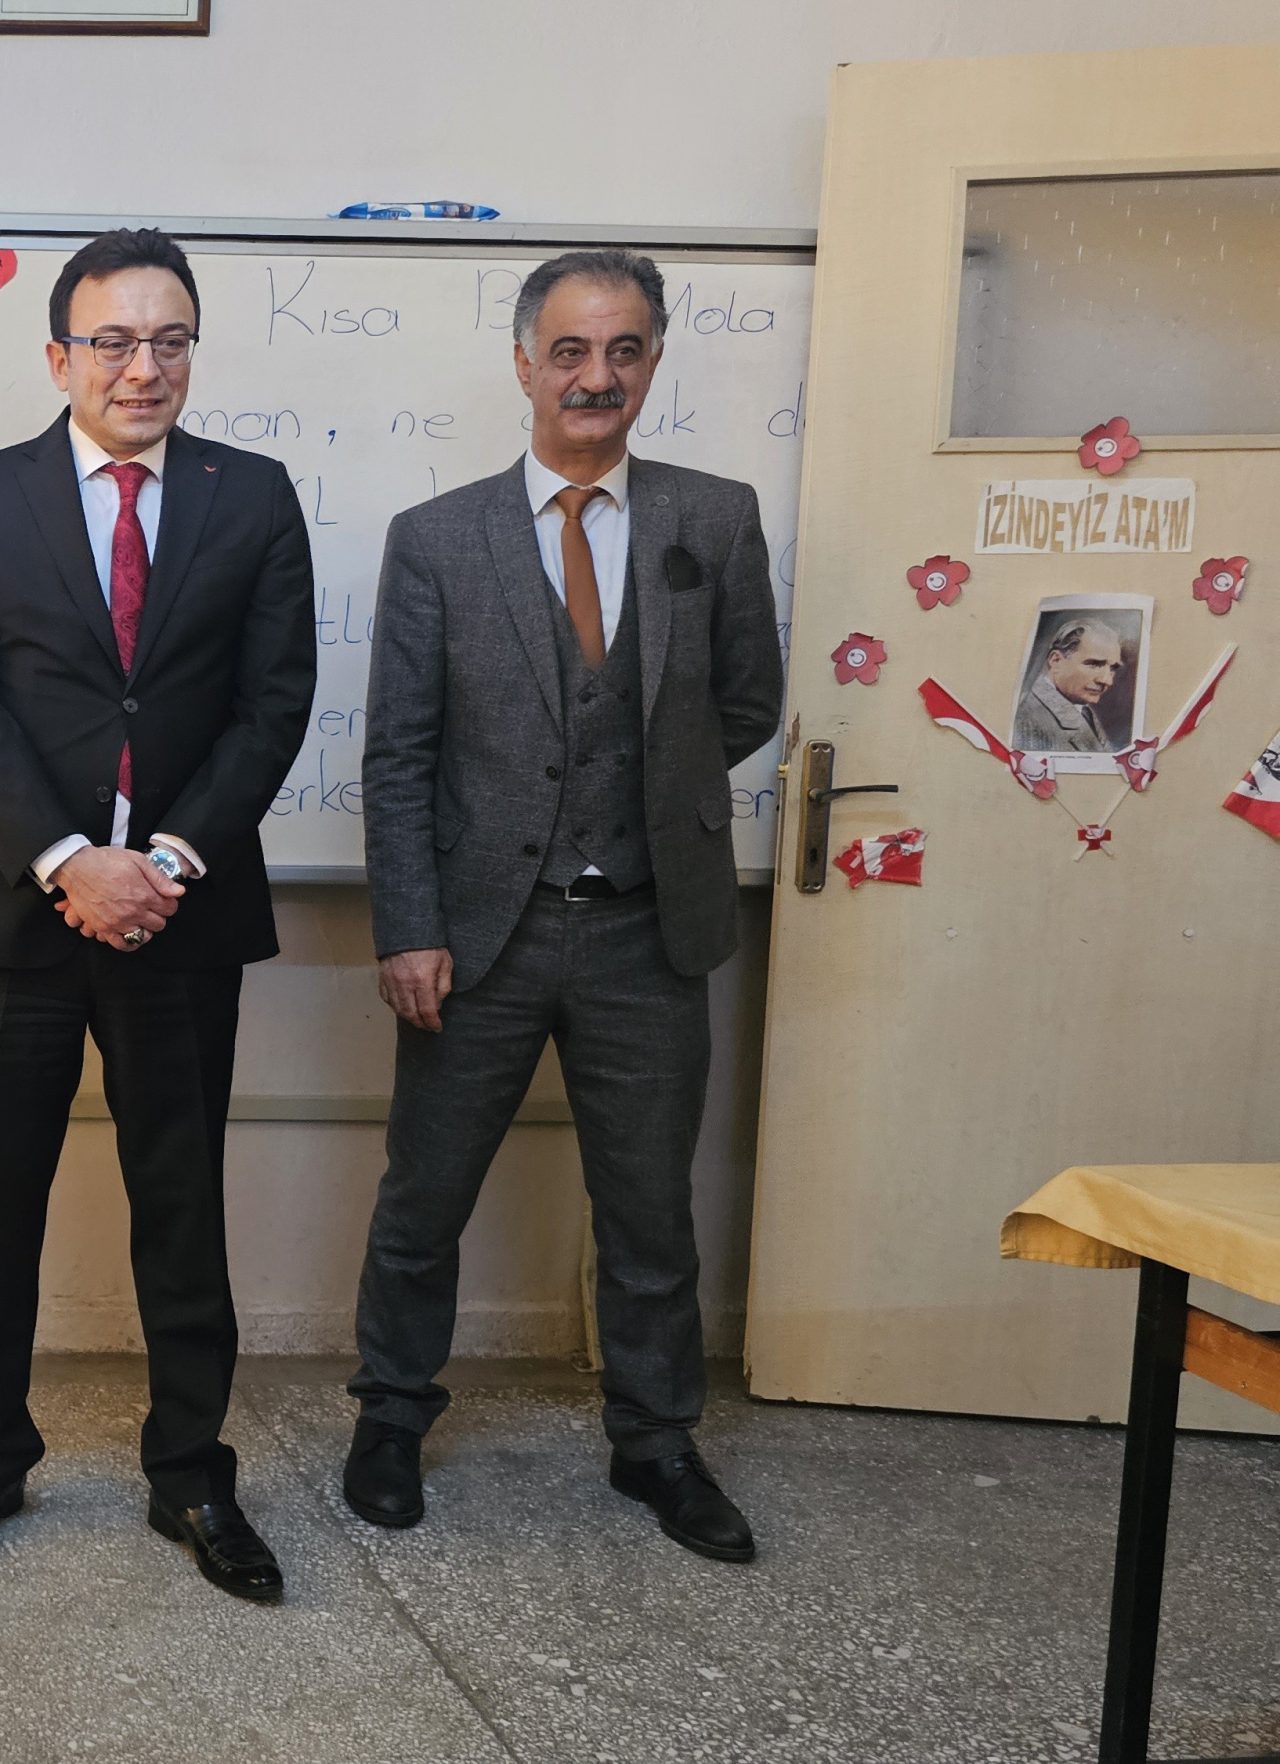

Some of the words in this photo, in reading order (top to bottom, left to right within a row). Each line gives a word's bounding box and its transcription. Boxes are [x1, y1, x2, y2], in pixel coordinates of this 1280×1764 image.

[266, 260, 400, 346] Kısa
[391, 410, 459, 440] ne
[767, 381, 806, 437] d
[982, 481, 1109, 553] İZİNDEYİZ
[1113, 494, 1190, 551] ATA'M
